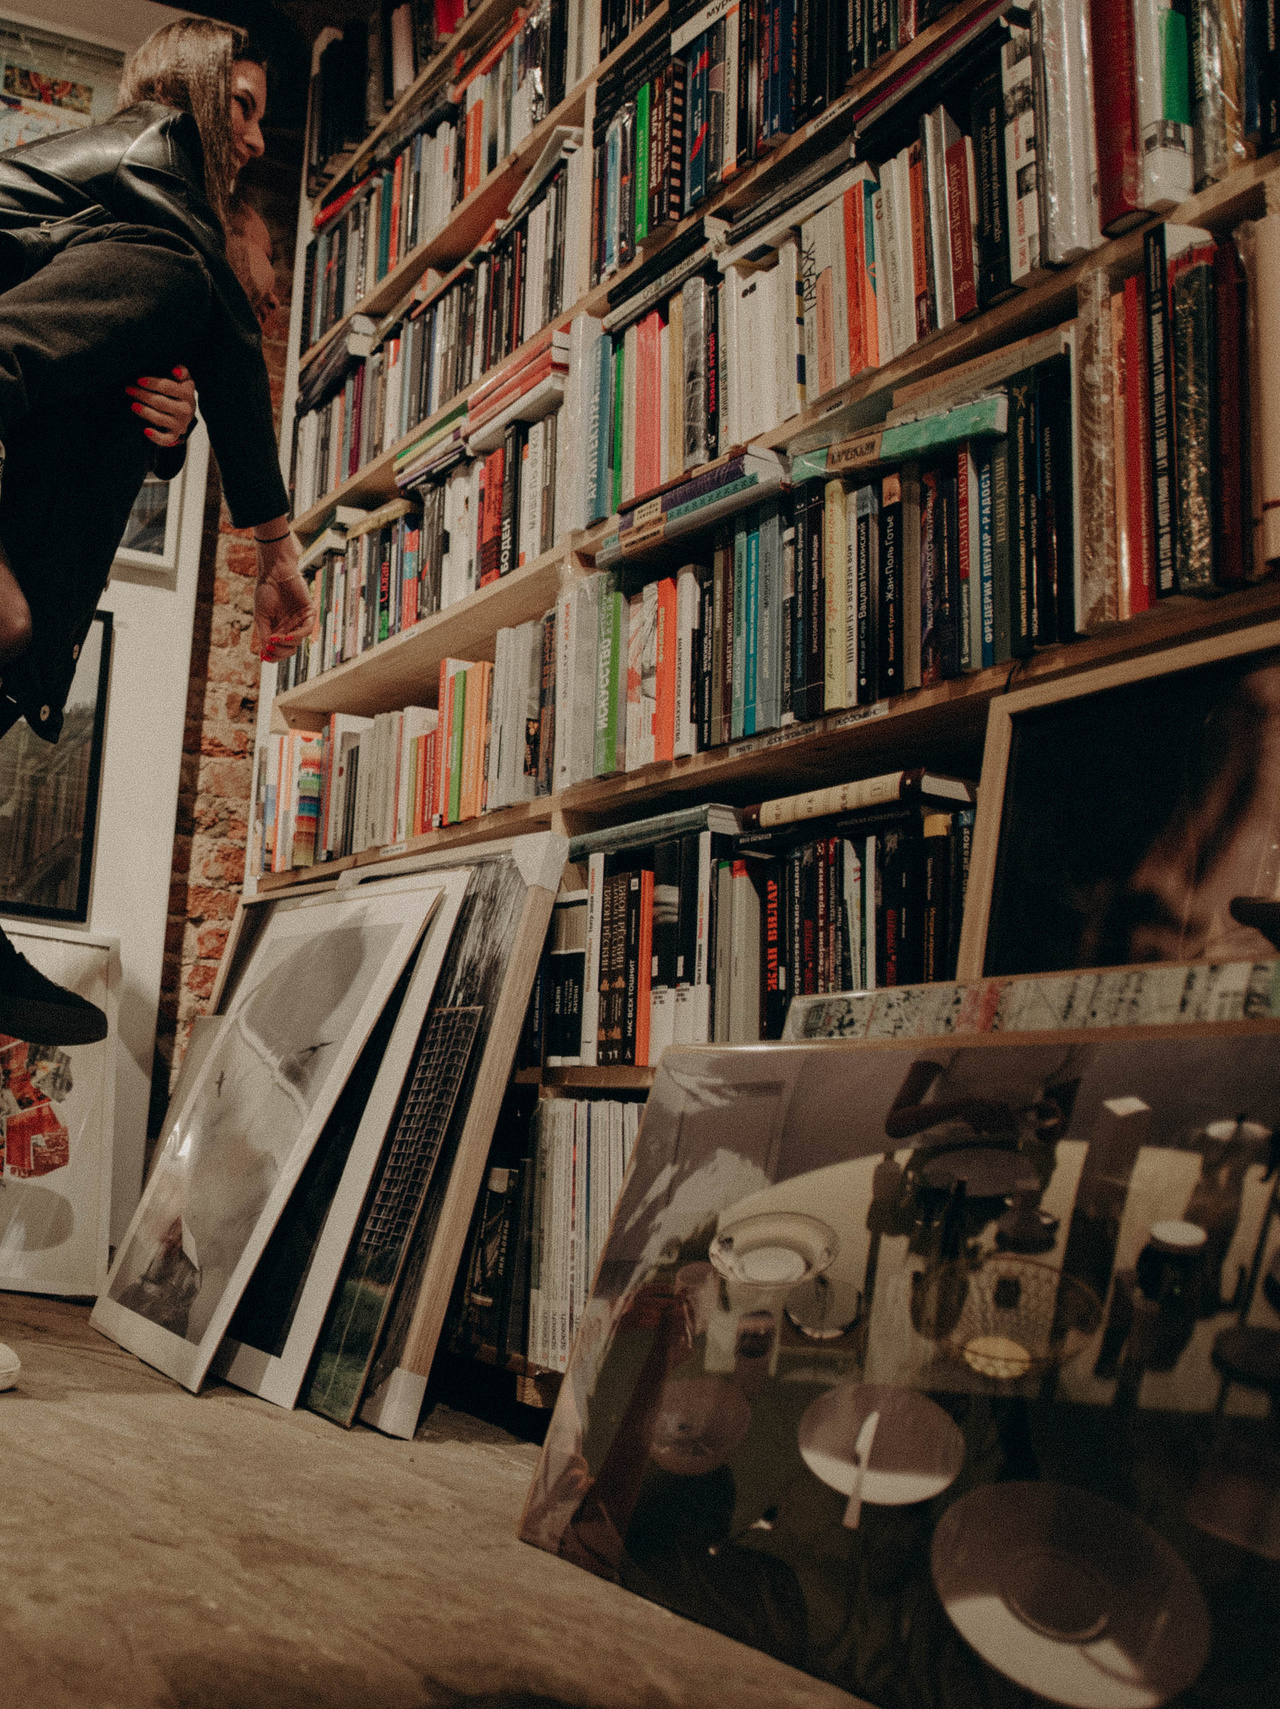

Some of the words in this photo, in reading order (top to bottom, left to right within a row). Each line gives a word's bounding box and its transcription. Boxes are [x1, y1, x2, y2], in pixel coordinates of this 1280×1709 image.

[949, 163, 962, 271] Санкт-Петербург
[802, 241, 817, 312] ГАРАЖ
[586, 391, 599, 499] АРХИТЕКТУРА
[982, 464, 991, 523] РАДОСТЬ
[500, 518, 511, 573] БОДЕН
[858, 522, 867, 580] Нижинский
[885, 515, 894, 545] Готье
[982, 532, 992, 577] ЛЕНУАР
[858, 581, 869, 618] Вацлав
[885, 546, 895, 601] Жан-Поль
[982, 581, 992, 643] ФРЕДЕРИК
[597, 638, 611, 730] ИСКУССТВО
[766, 880, 778, 941] ВИЛАР
[766, 947, 778, 991] ЖАН
